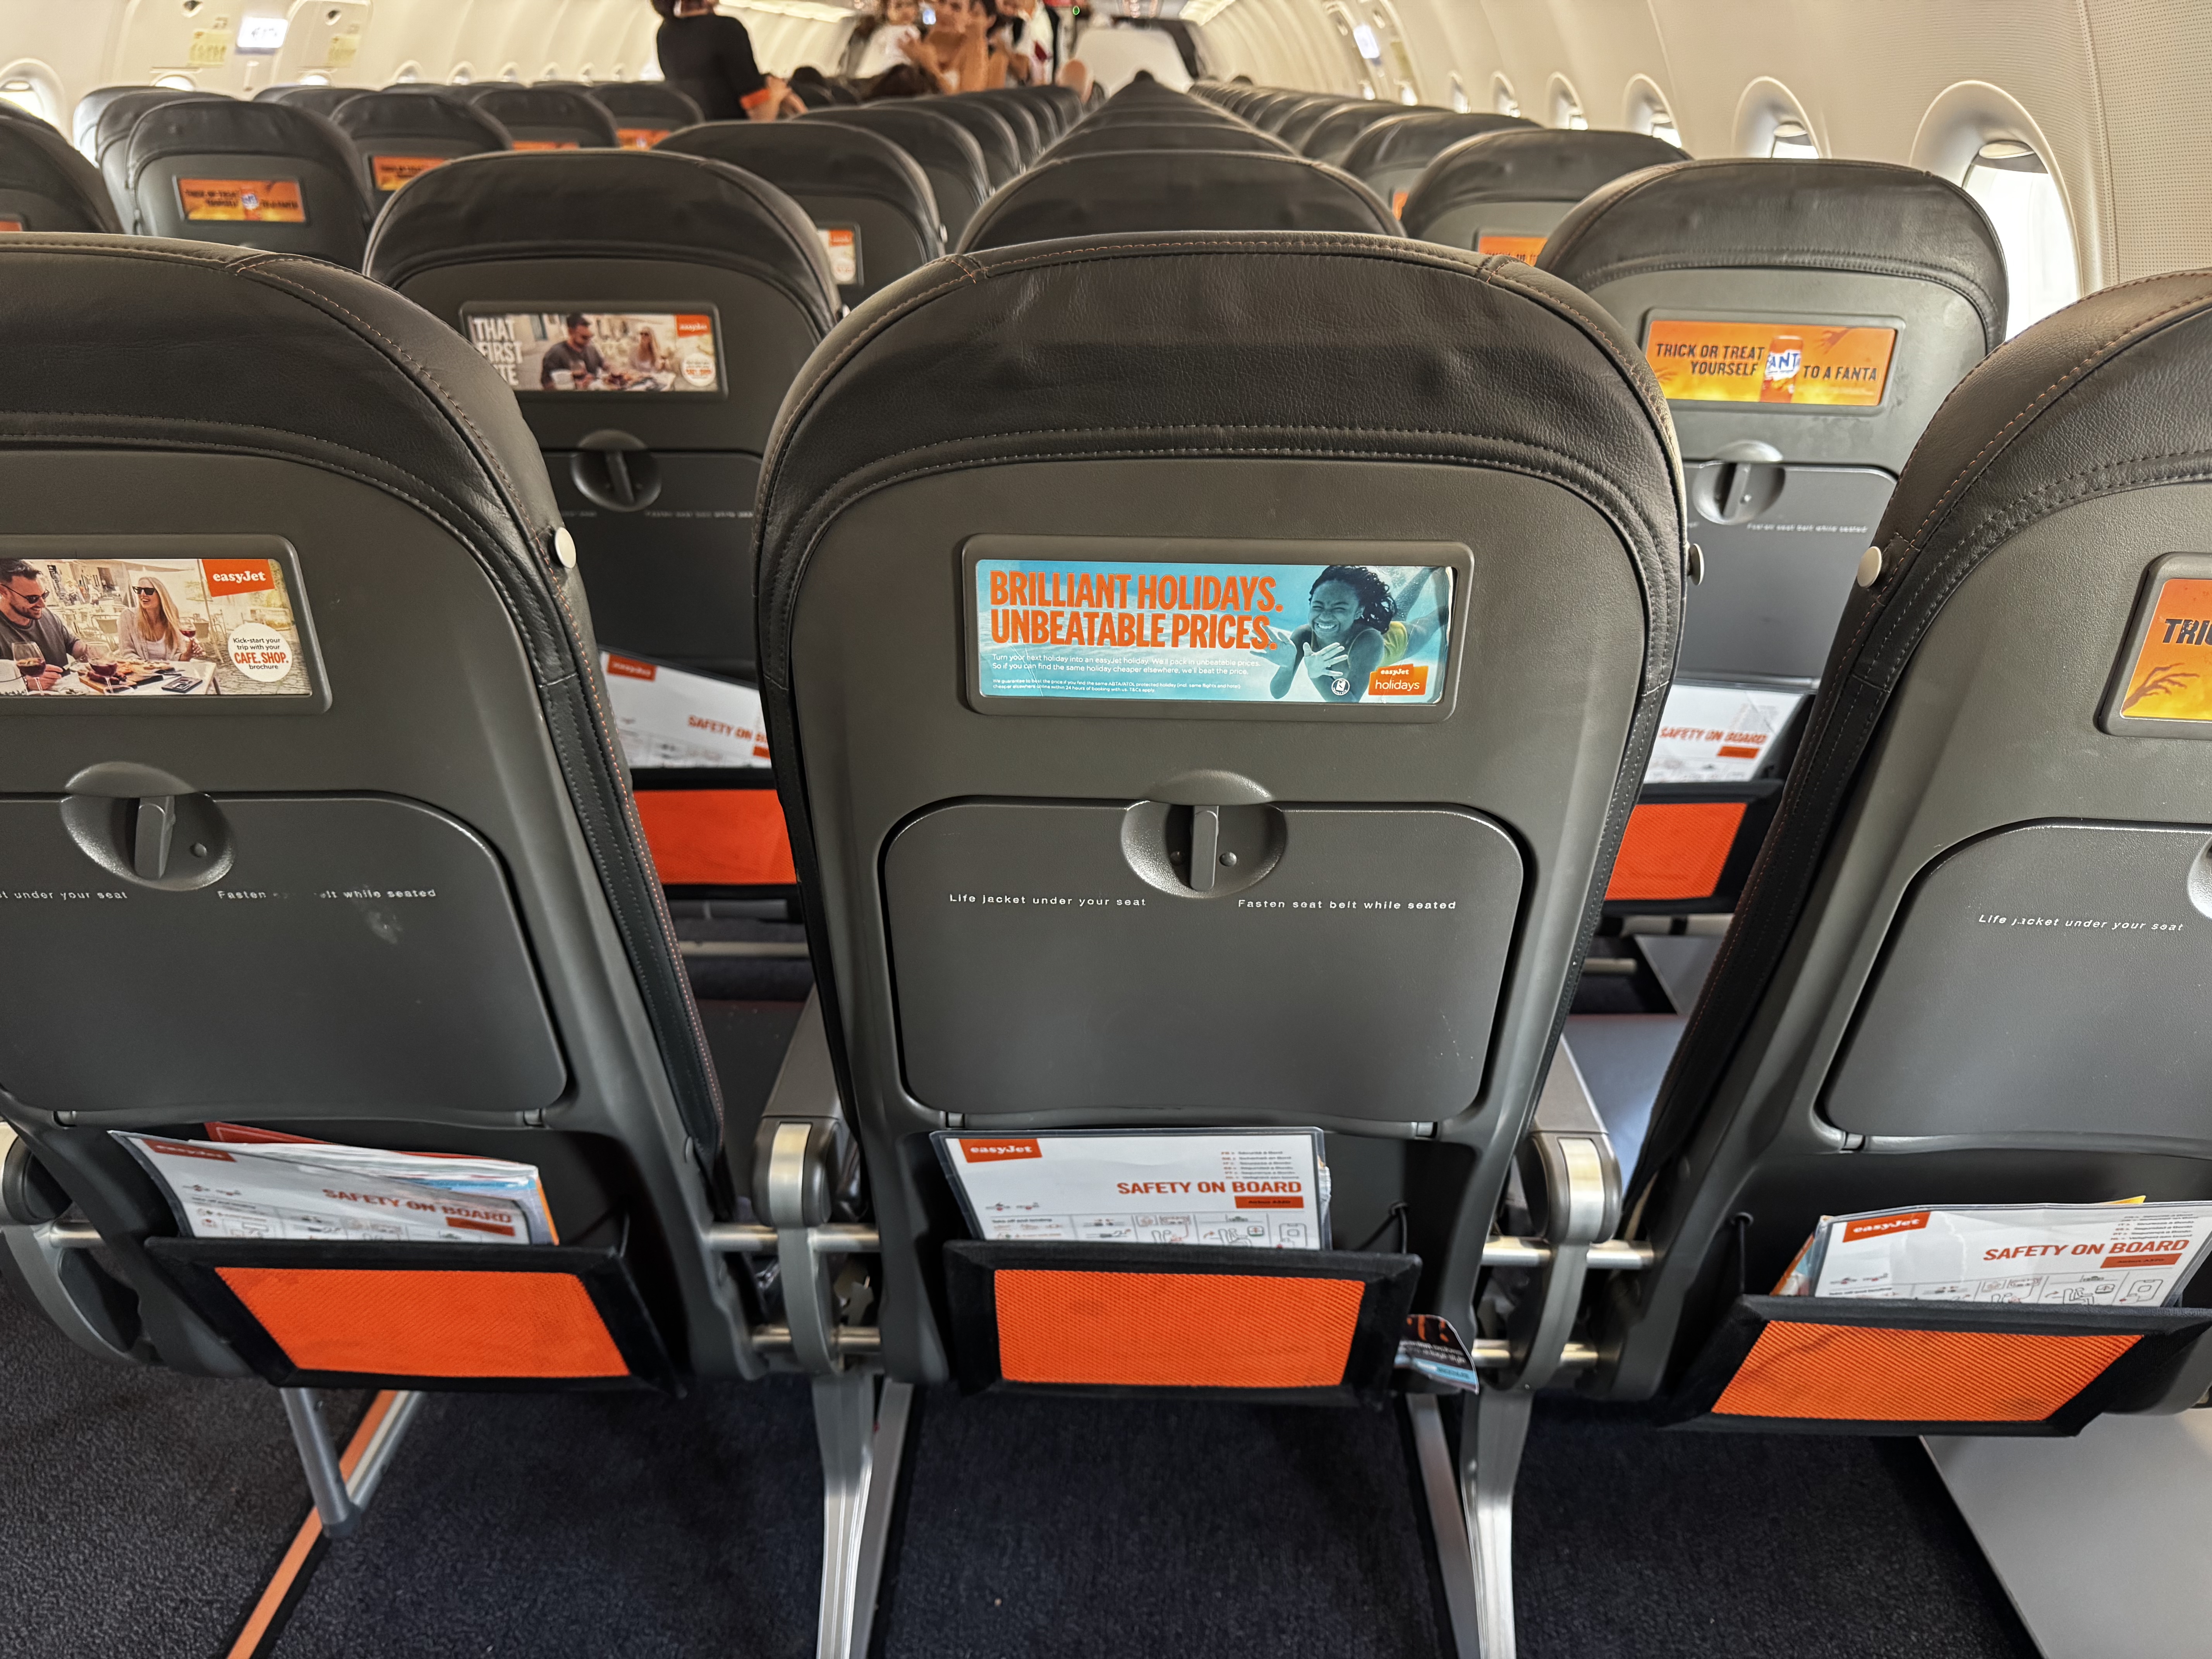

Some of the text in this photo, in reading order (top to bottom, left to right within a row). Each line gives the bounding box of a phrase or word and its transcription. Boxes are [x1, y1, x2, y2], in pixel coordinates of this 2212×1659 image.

[474, 318, 515, 341] THAT
[1657, 343, 1765, 361] TRICK OR TREAT
[1691, 361, 1758, 376] YOURSELF
[1804, 365, 1877, 381] TO A FANTA
[213, 571, 266, 584] easyJet
[990, 570, 1284, 612] BRILLIANT HOLIDAYS.
[991, 609, 1277, 650] UNBEATABLE PRICES.
[234, 652, 289, 664] CAFE. SHOP.
[1375, 679, 1420, 691] holidays
[14, 891, 53, 899] under
[60, 892, 89, 901] your
[217, 890, 266, 899] Fasten
[343, 890, 381, 898] while
[387, 890, 436, 898] seated
[950, 894, 1146, 907] Life jacket under your seat
[1238, 899, 1456, 910] Fasten seat belt while seated
[1978, 914, 2007, 924] Life
[2065, 919, 2108, 928] under
[2112, 922, 2147, 930] your
[2151, 923, 2184, 931] seat
[970, 1145, 1033, 1154] easyJet
[1116, 1181, 1302, 1194] SAFETY ON BOARD
[322, 1188, 512, 1223] SAFETY ON BOARD
[1853, 1219, 1920, 1233] easyJet
[1984, 1240, 2189, 1261] SAFETY ON BOARD
